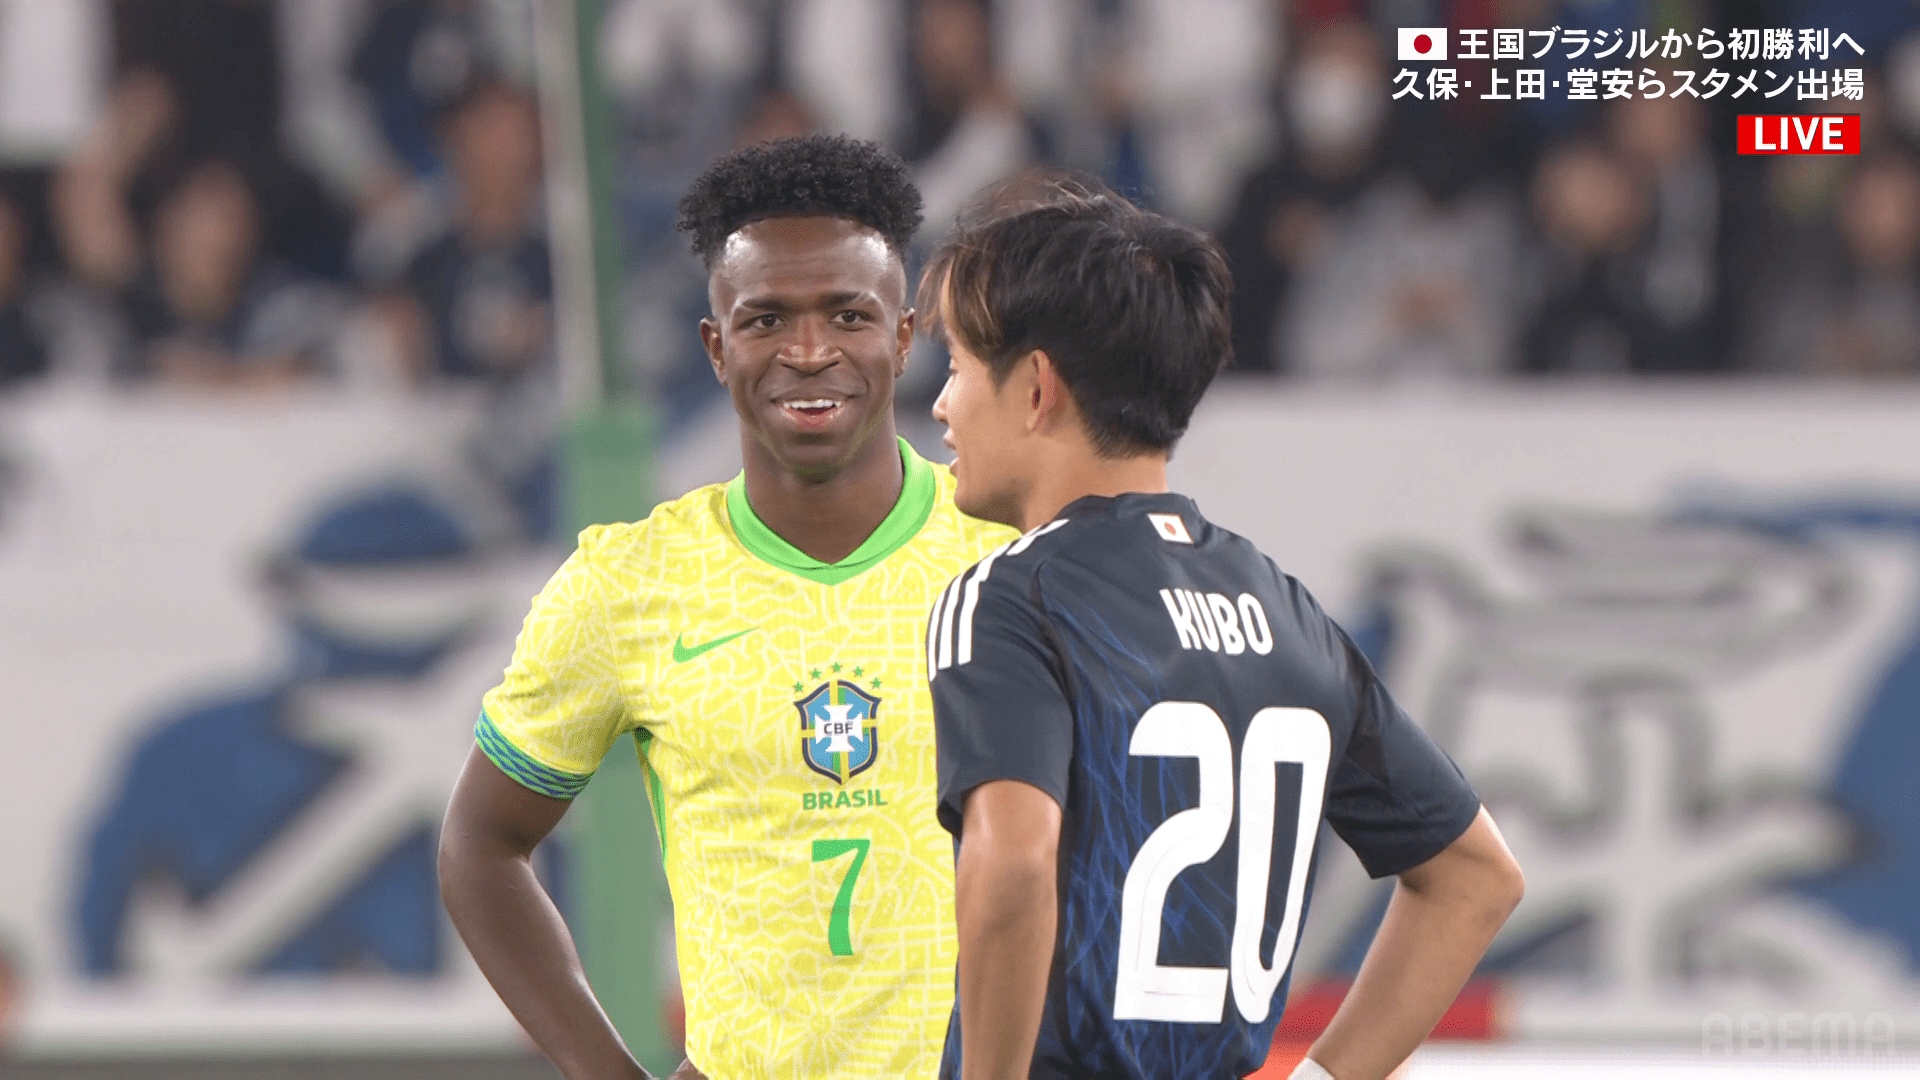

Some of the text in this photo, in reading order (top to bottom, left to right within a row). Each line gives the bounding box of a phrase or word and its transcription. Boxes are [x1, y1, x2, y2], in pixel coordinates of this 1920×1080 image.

[1159, 588, 1273, 655] KUBO
[823, 721, 855, 735] CBF
[803, 789, 888, 810] BRASIL
[1113, 701, 1332, 1023] 20
[811, 839, 871, 957] 7
